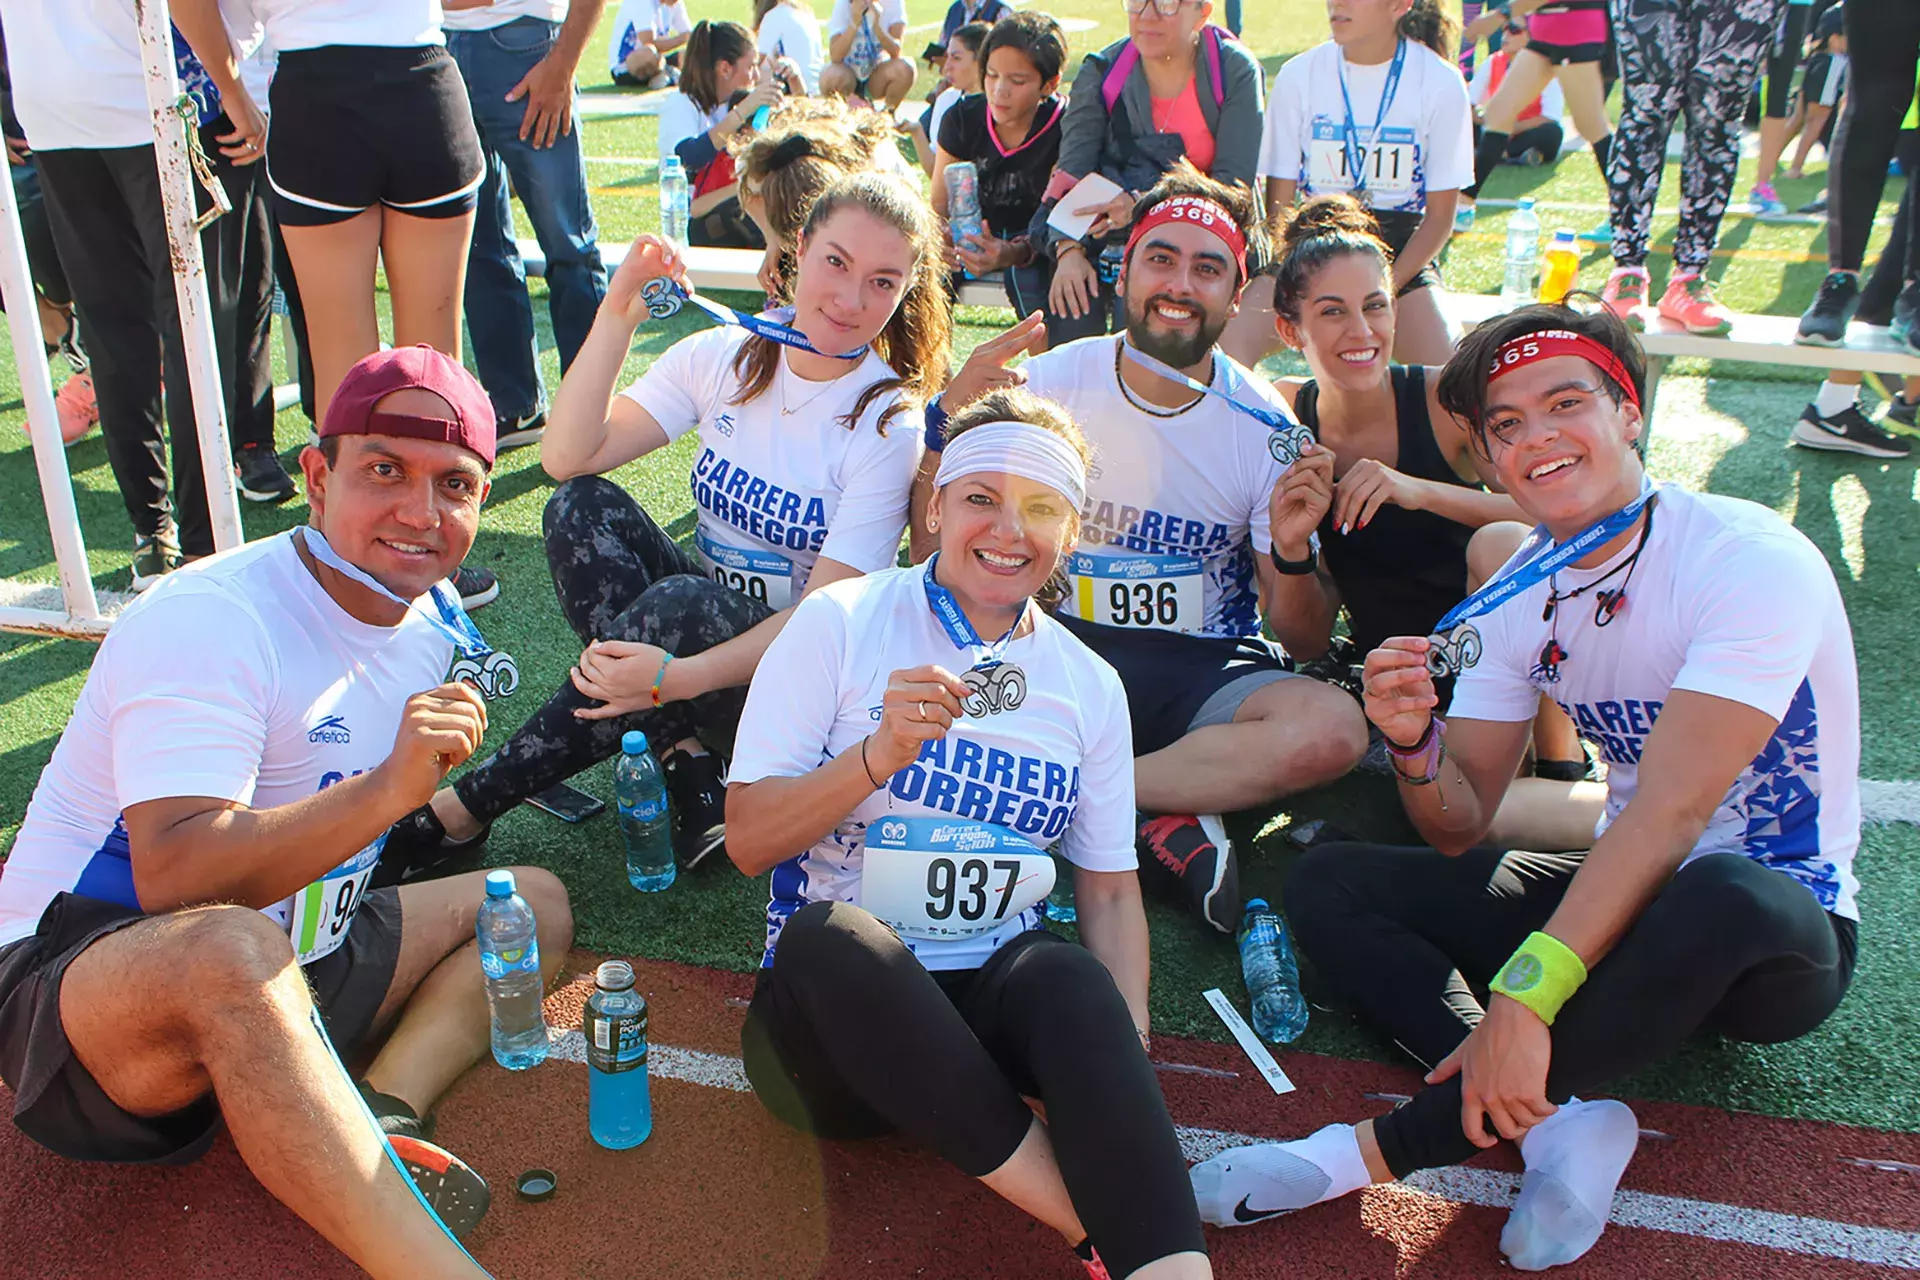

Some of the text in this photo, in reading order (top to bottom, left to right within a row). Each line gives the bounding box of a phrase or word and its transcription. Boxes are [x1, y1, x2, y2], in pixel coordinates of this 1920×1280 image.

[1171, 207, 1214, 226] 369
[697, 447, 825, 528] CARRERA
[1110, 582, 1178, 626] 936
[915, 738, 1079, 803] ARRERA
[632, 803, 656, 818] ciel
[925, 857, 1021, 921] 937
